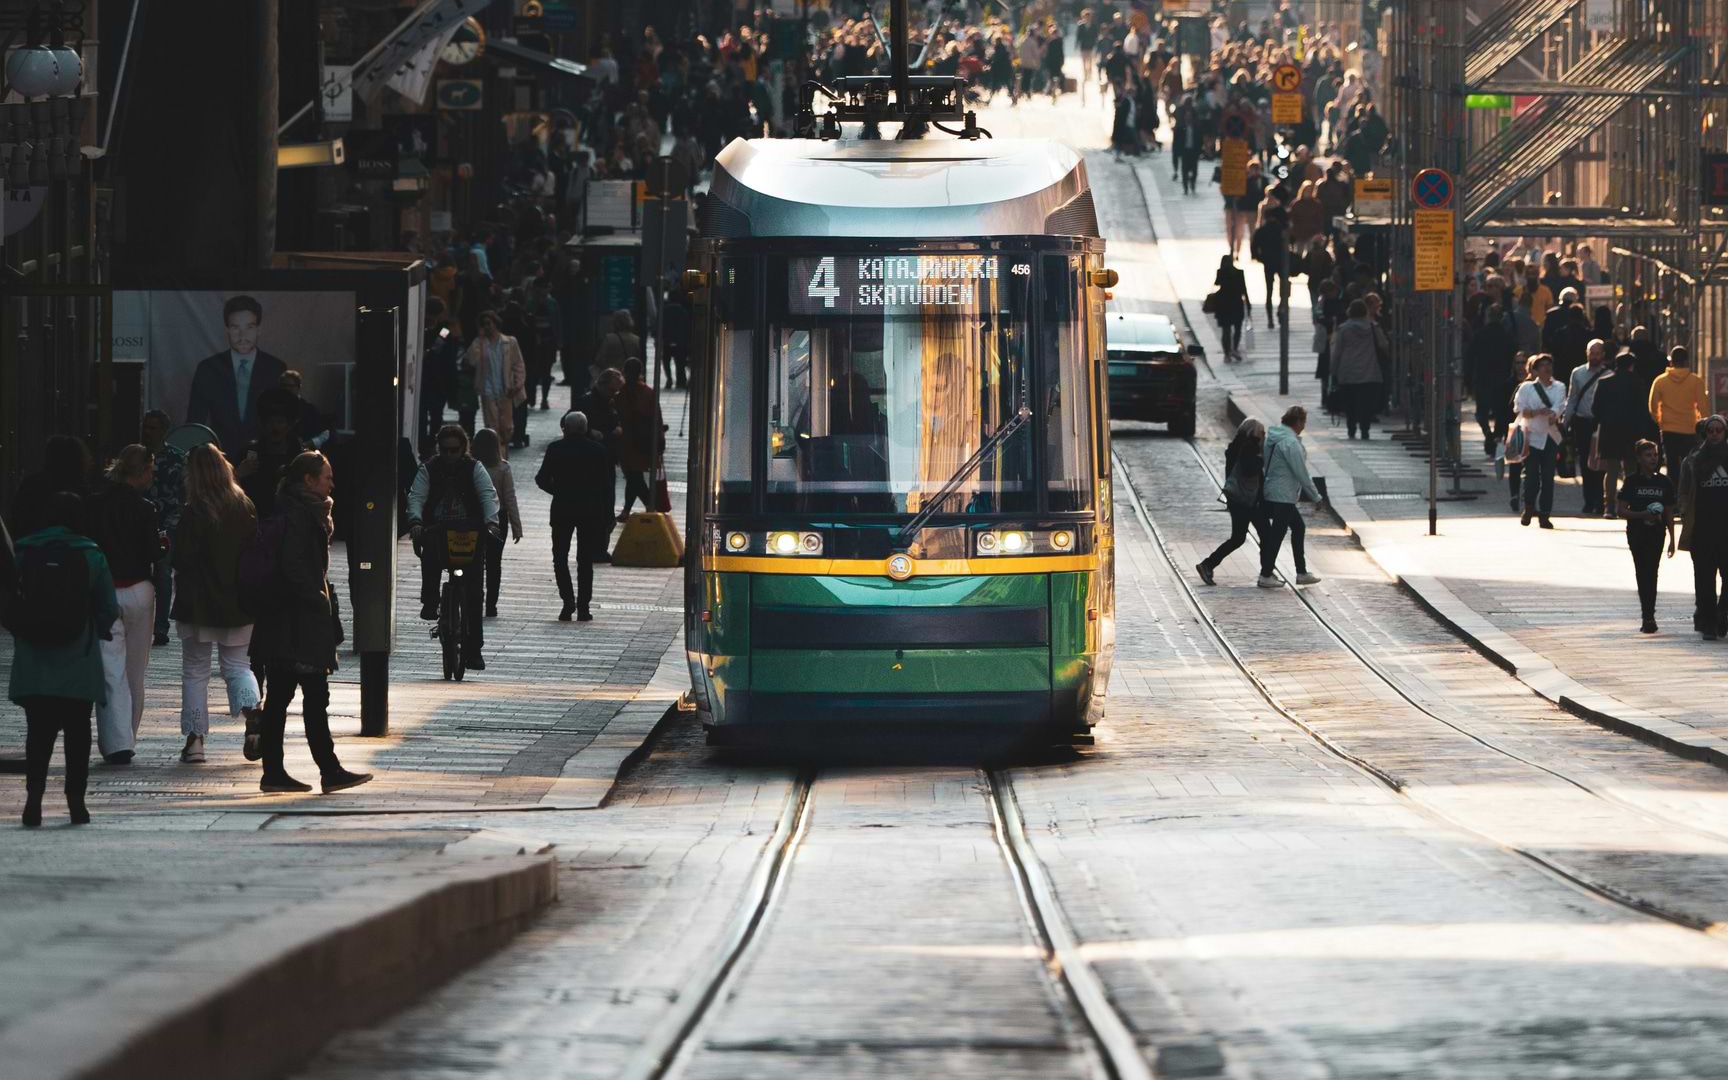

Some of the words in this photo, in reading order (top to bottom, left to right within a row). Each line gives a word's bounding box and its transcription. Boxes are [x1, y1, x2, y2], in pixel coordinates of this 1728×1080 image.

[358, 159, 391, 169] BOSS
[858, 258, 998, 279] KATAJANOKKA
[1011, 264, 1030, 275] 456
[807, 256, 840, 308] 4
[858, 284, 973, 306] SKATUDDEN
[1700, 477, 1728, 488] adida
